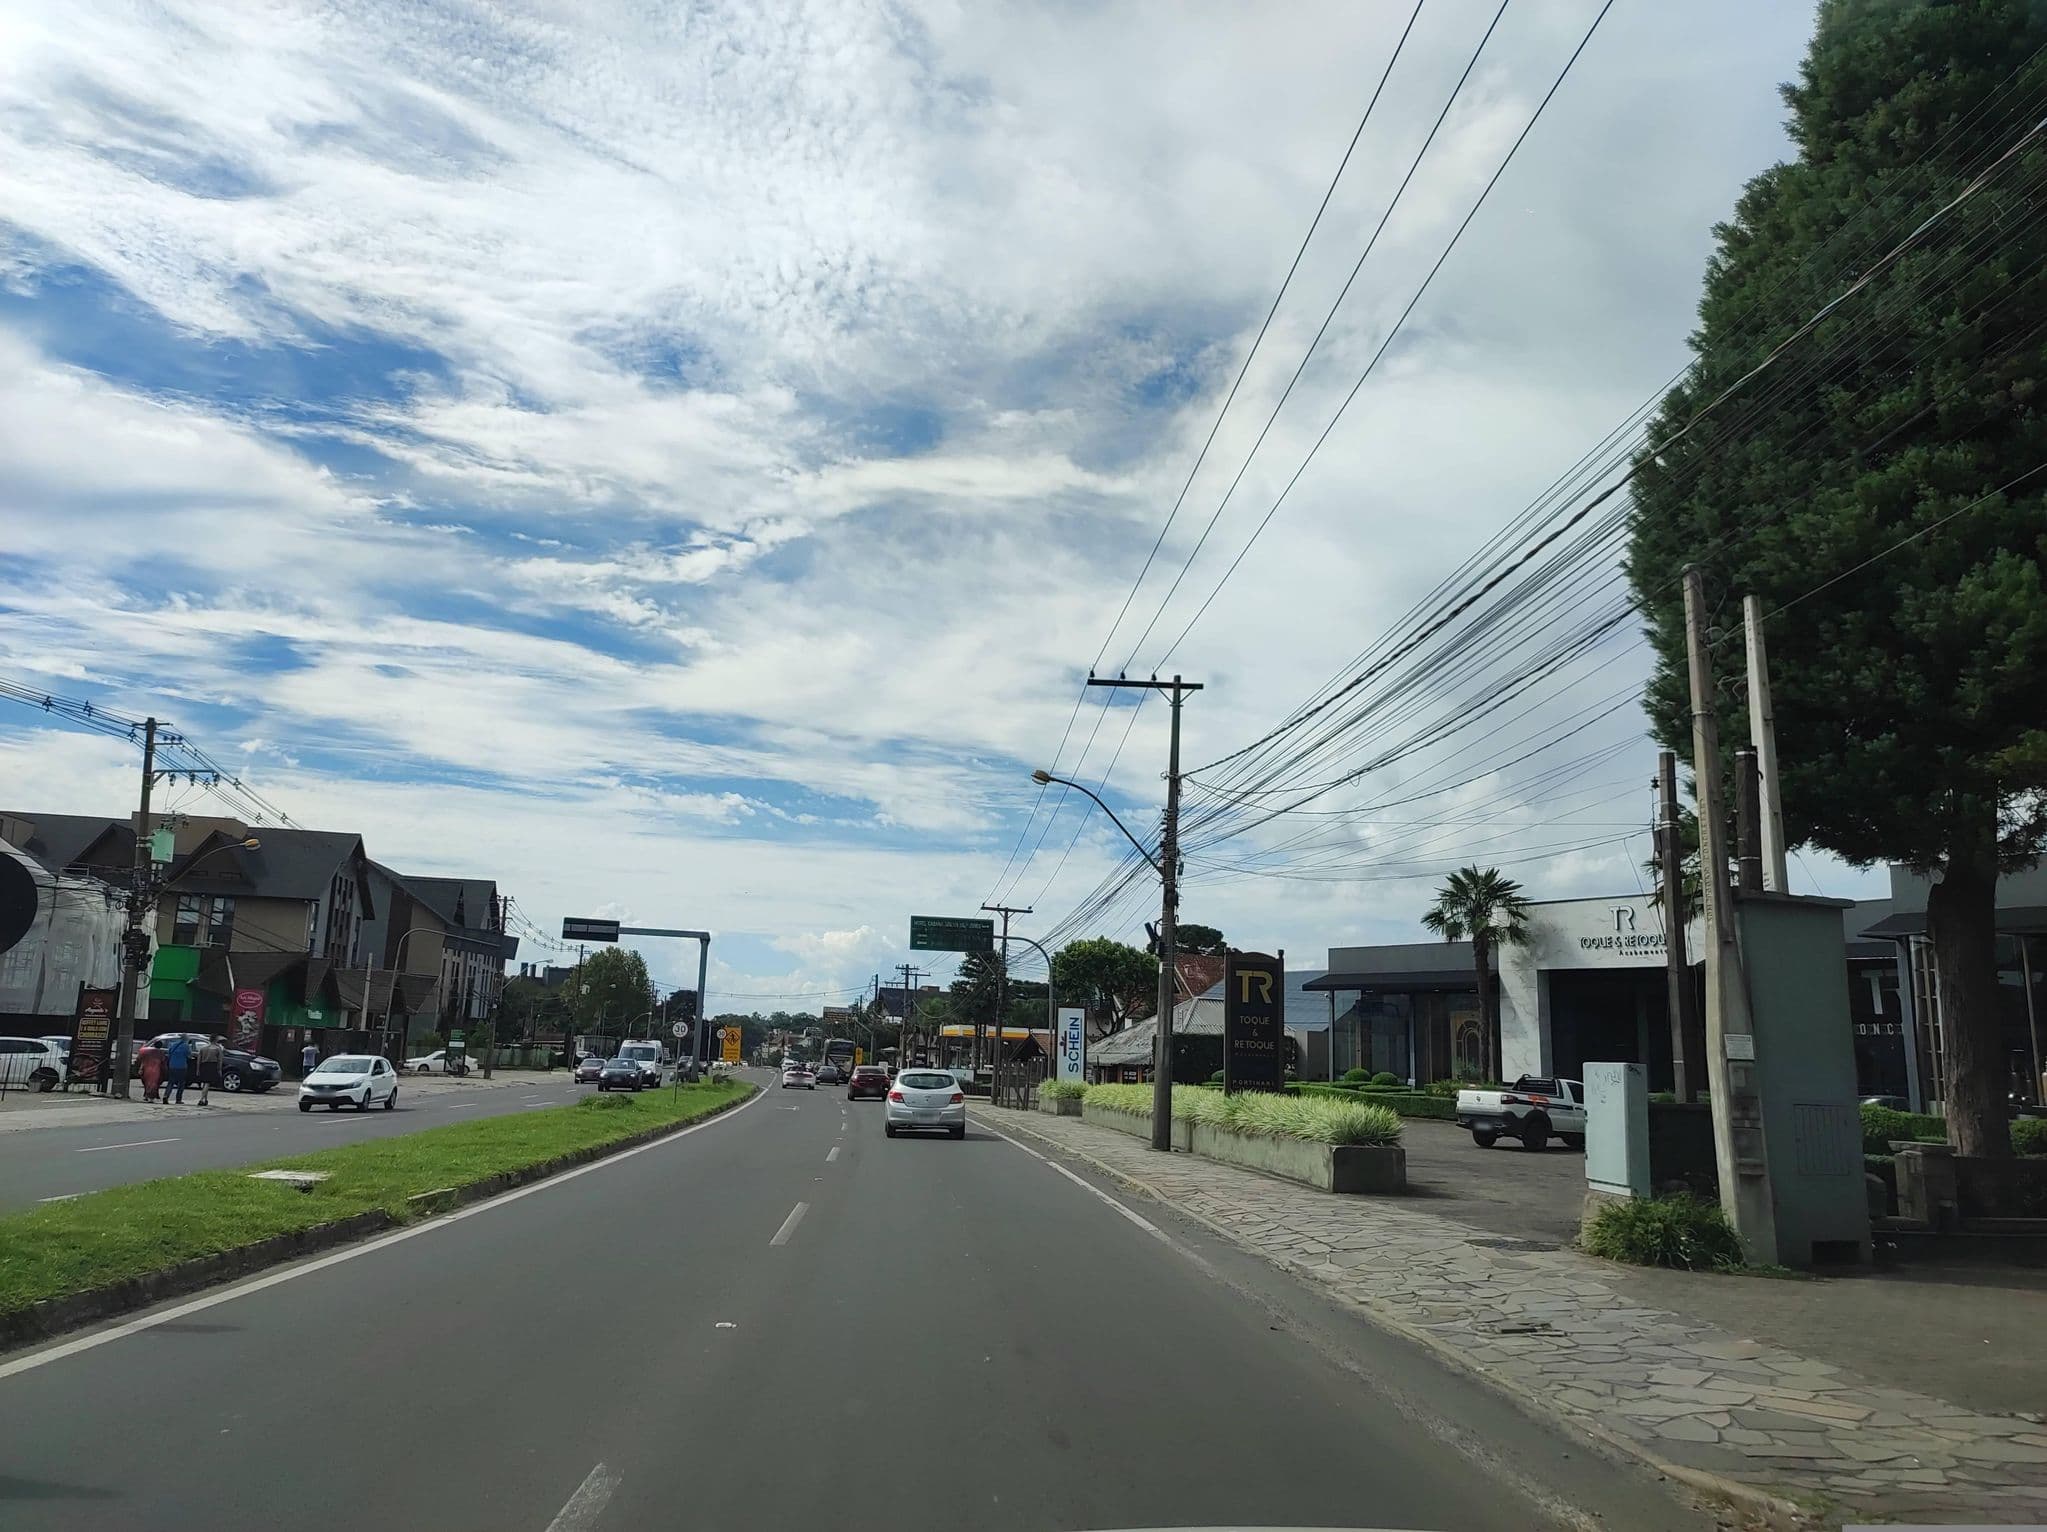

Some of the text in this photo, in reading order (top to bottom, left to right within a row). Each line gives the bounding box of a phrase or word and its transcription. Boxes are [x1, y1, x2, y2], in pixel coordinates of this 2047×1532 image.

[1608, 905, 1635, 931] TR
[1624, 934, 1667, 947] RETOQU
[1235, 970, 1273, 1004] TR
[1240, 1015, 1270, 1025] TOQUE
[674, 1024, 687, 1033] 30
[1068, 1017, 1079, 1073] SCHEIN
[1234, 1040, 1275, 1050] RETOQUE
